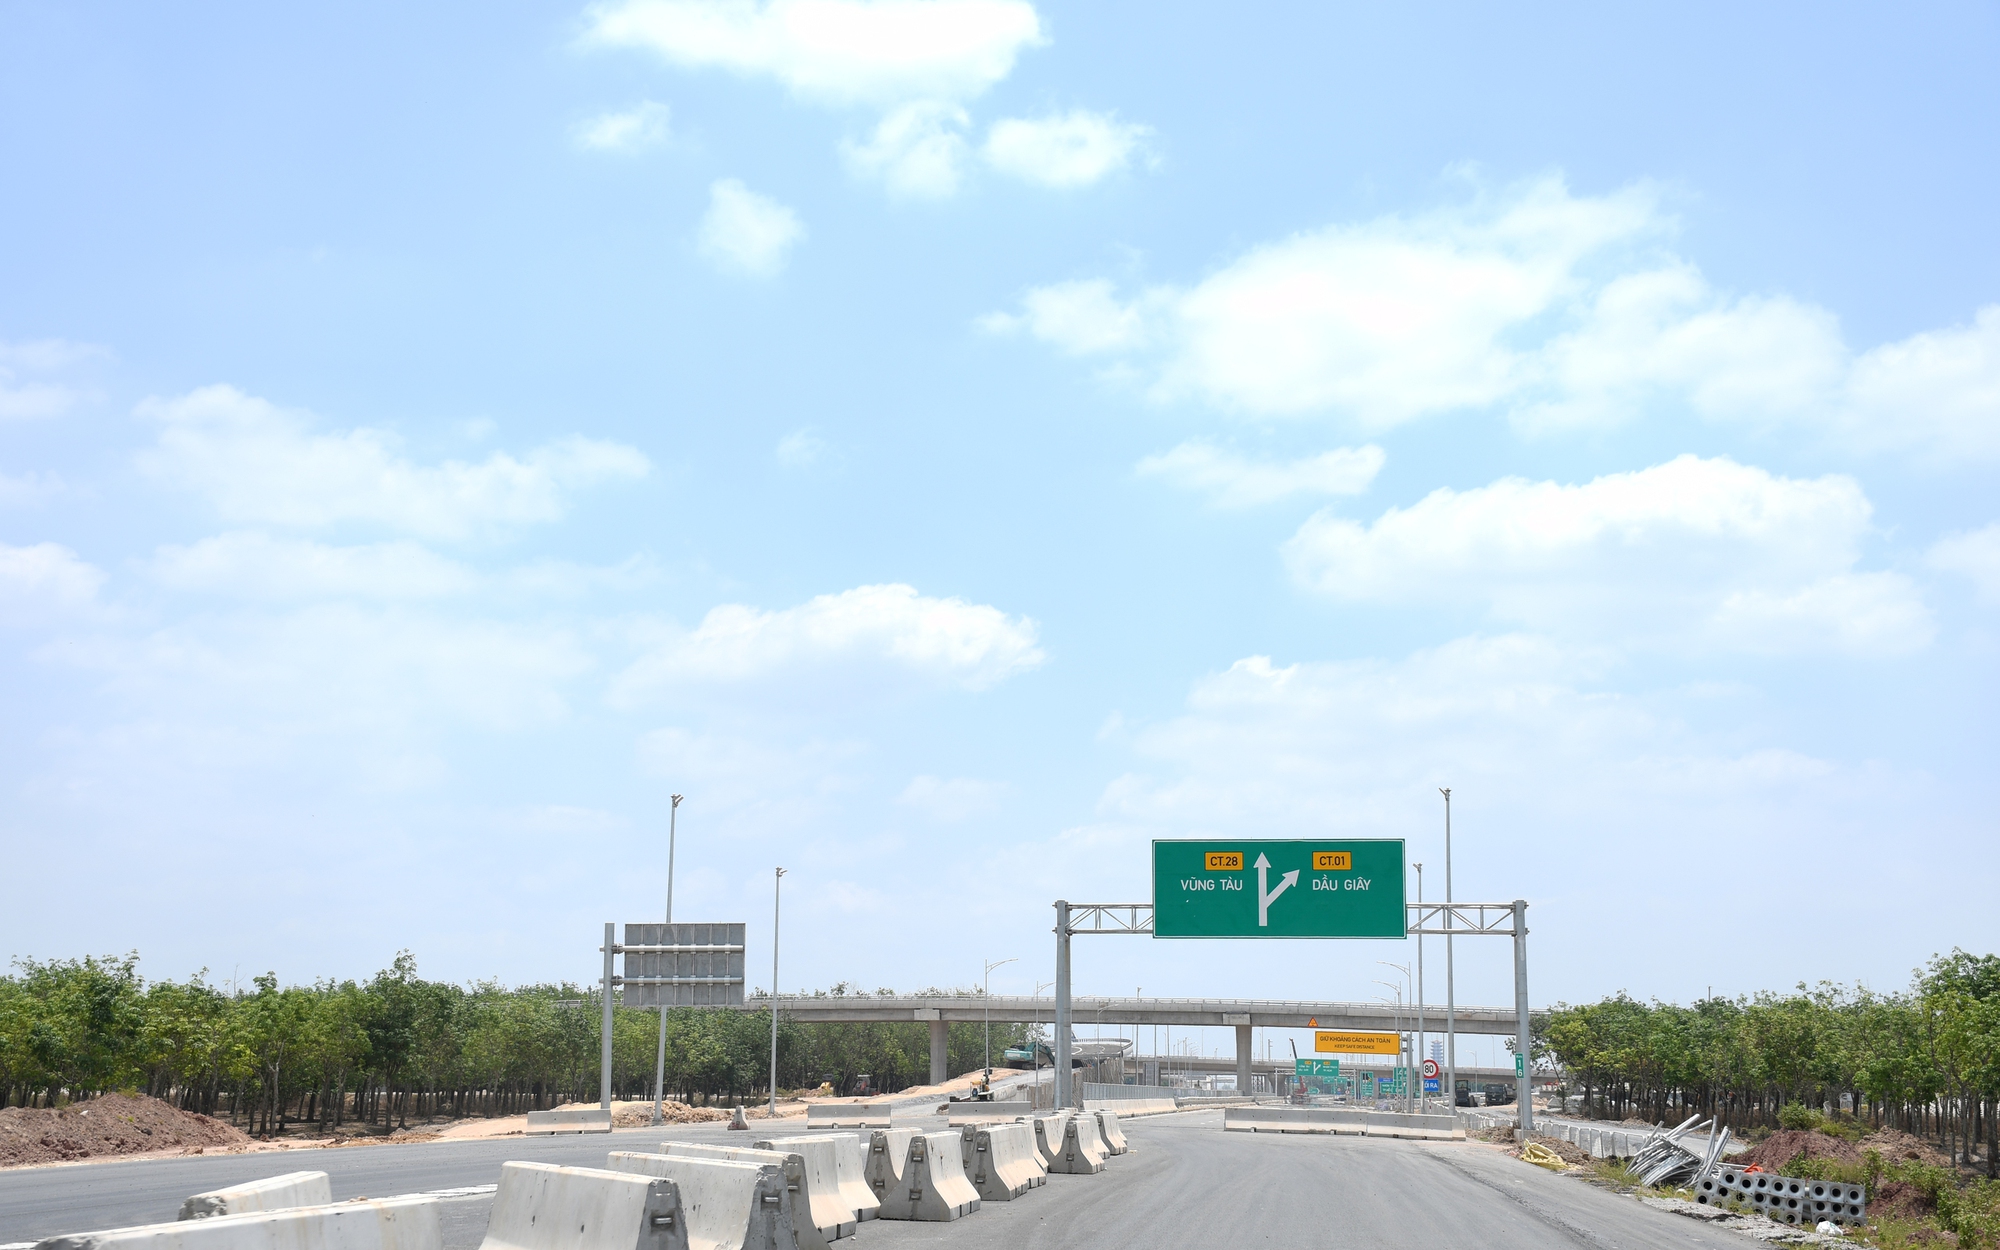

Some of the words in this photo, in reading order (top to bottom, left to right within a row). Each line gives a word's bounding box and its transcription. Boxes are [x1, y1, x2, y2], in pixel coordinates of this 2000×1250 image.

[1210, 856, 1238, 866] CT.28
[1319, 855, 1345, 866] CT.01
[1180, 876, 1215, 891] VŨNG
[1219, 876, 1243, 891] TÀU
[1312, 874, 1338, 891] DẦU
[1344, 876, 1371, 891] GIÂY
[1425, 1065, 1433, 1073] 80
